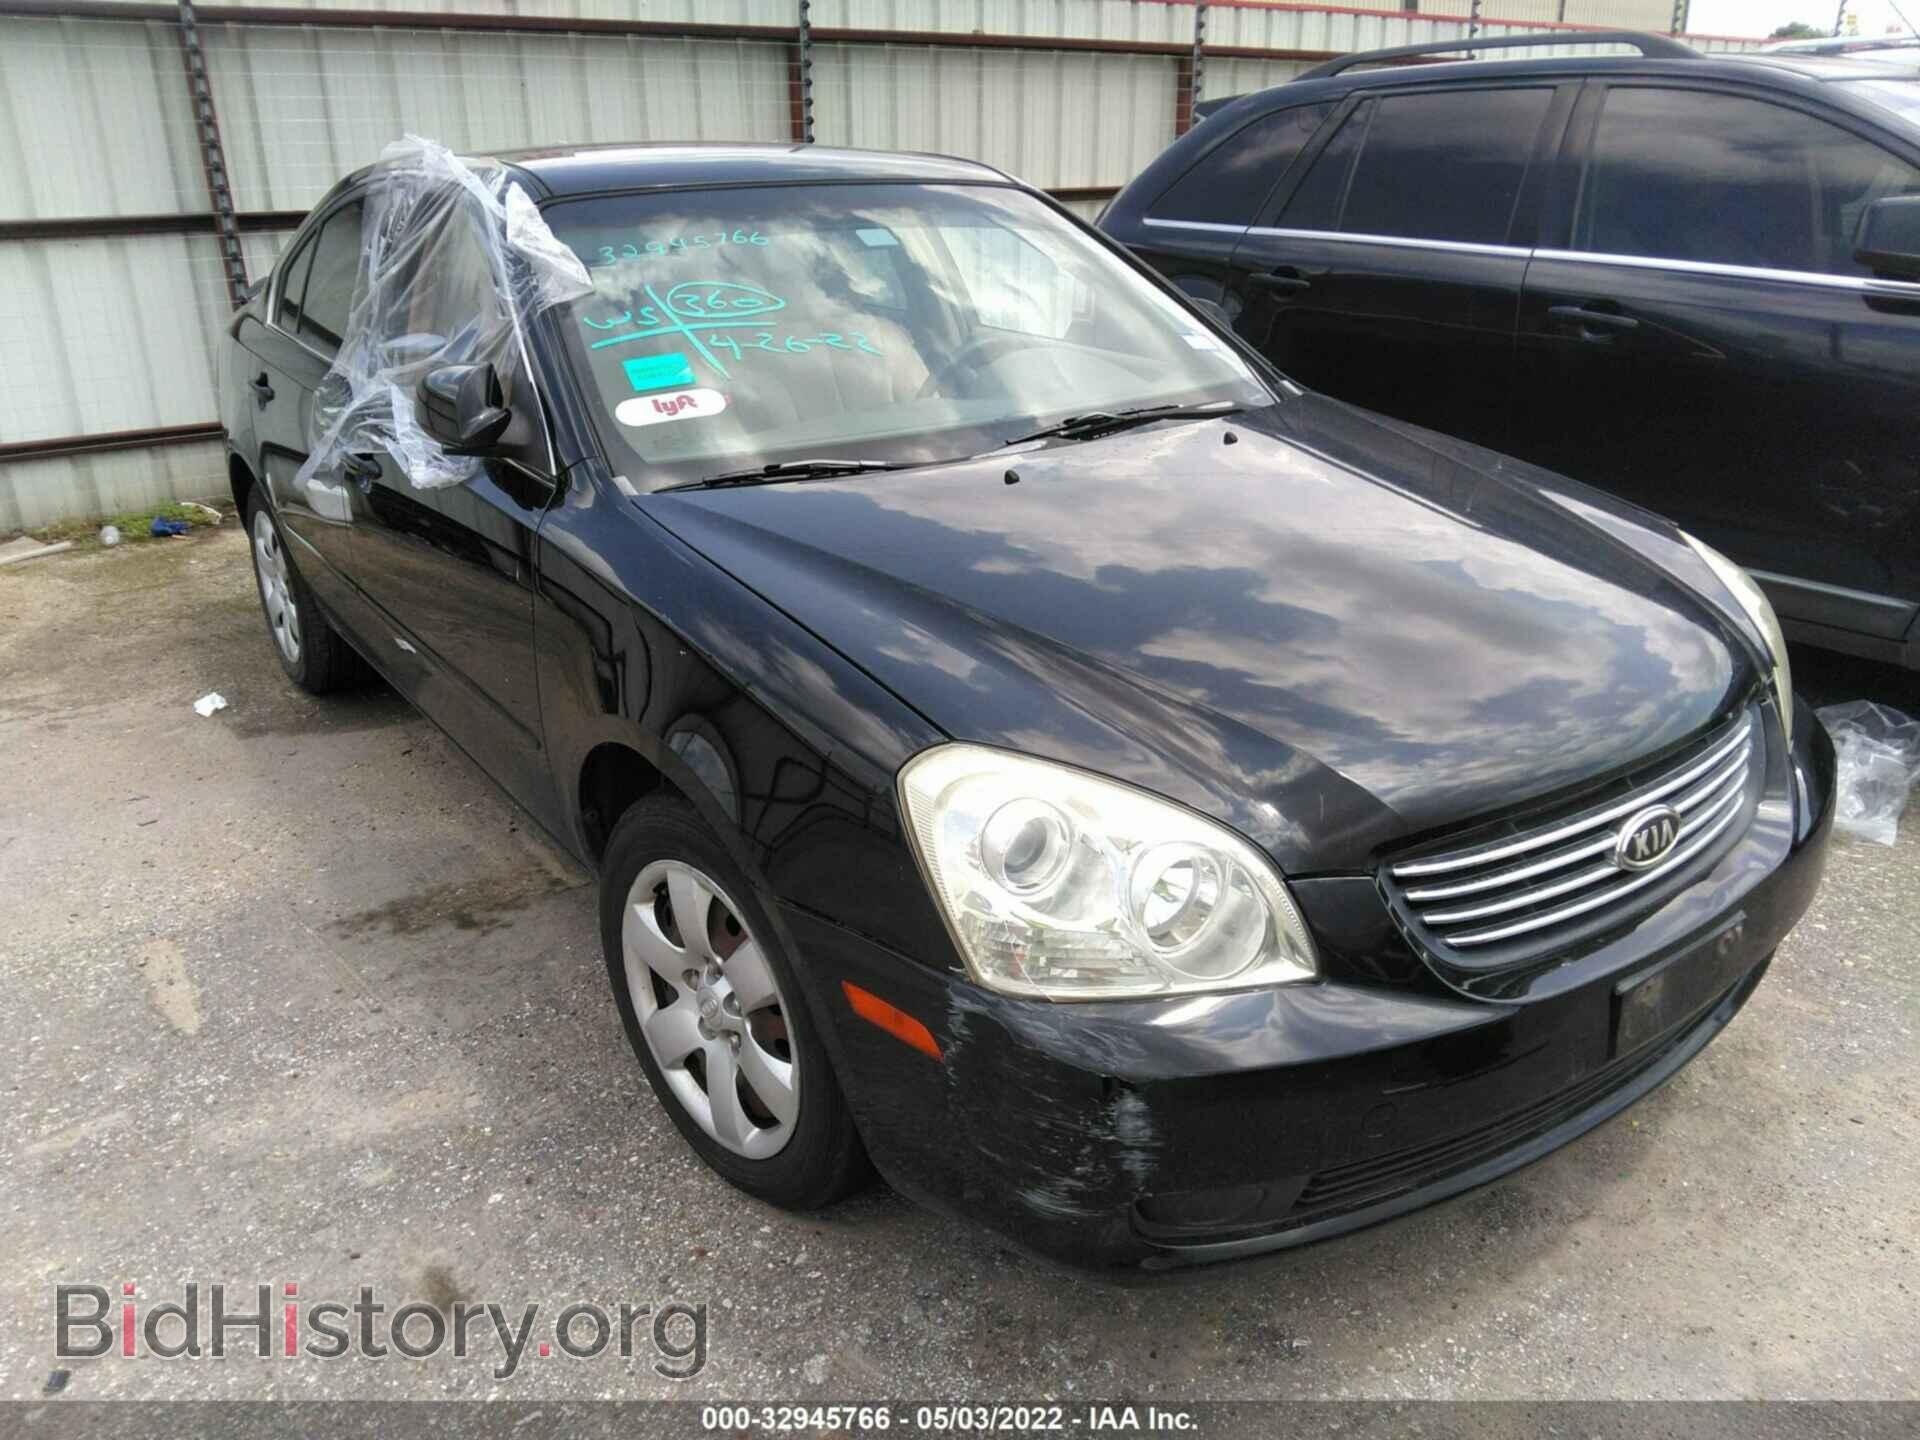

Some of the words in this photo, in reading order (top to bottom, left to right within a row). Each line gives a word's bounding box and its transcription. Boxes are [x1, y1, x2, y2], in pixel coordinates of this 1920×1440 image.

[599, 228, 770, 265] 32945766
[673, 288, 765, 316] 360
[1632, 818, 1674, 860] KIA
